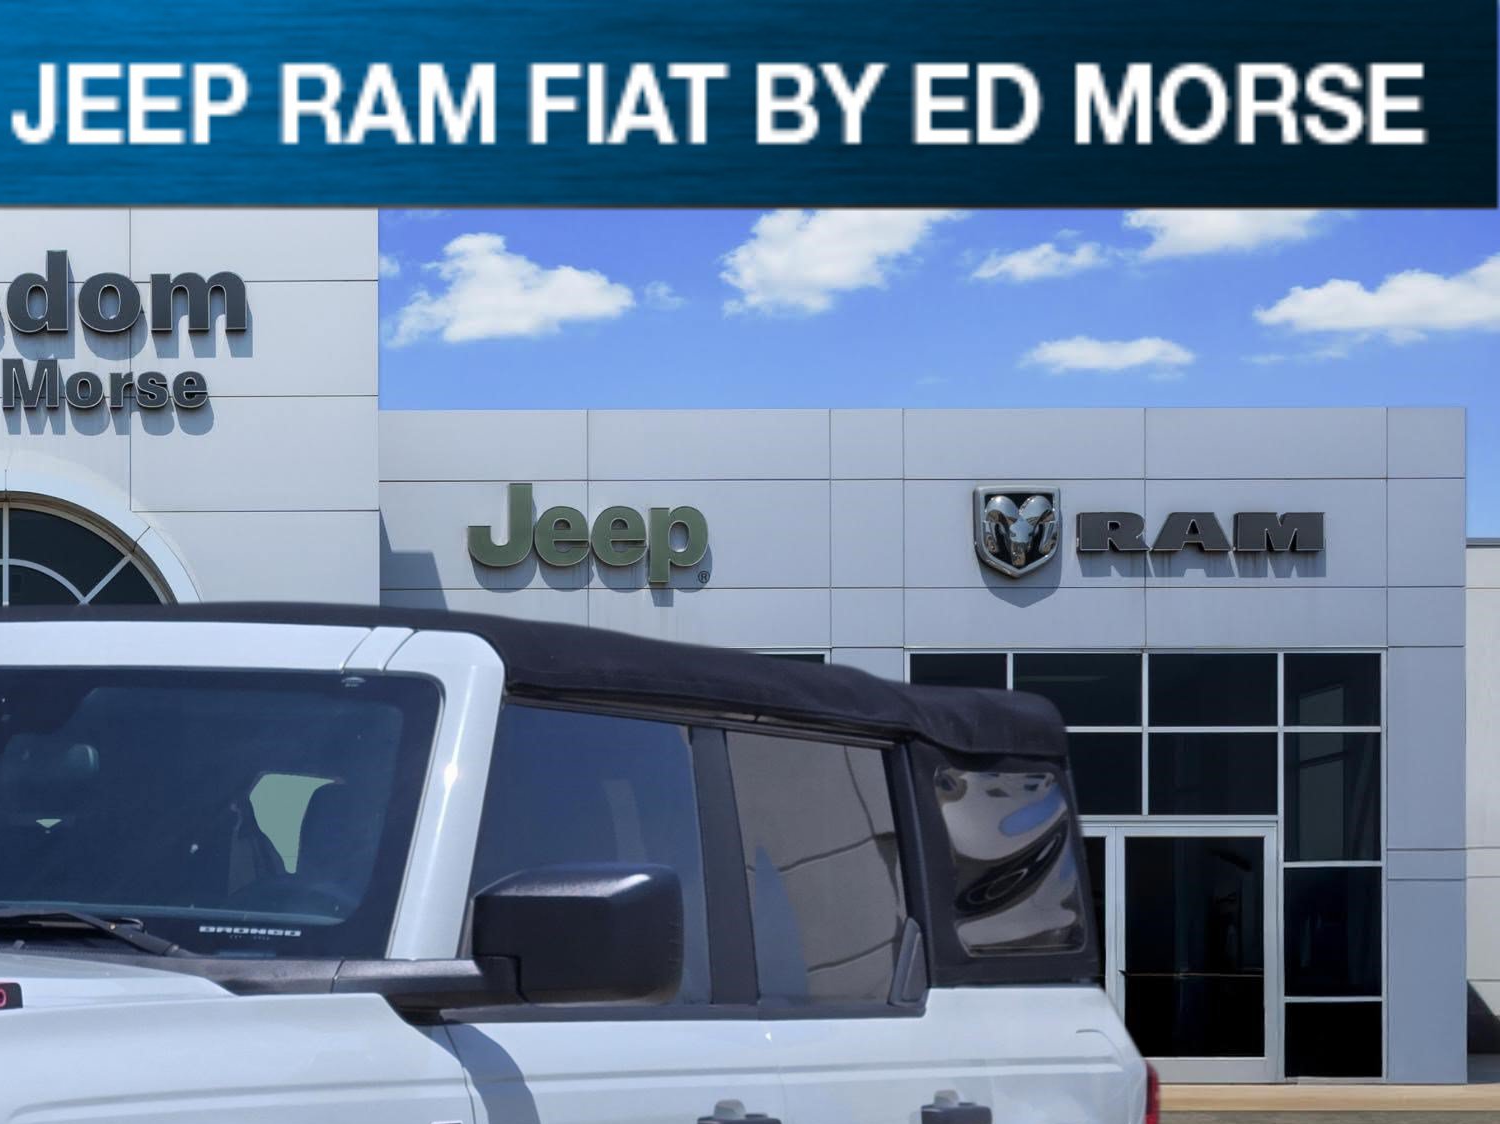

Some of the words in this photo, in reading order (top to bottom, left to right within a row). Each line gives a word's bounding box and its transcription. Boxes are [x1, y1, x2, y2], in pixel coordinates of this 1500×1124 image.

[1, 358, 209, 409] Morse
[467, 482, 709, 583] Jeep
[1075, 511, 1326, 552] RAM
[198, 925, 302, 937] BRONCO
